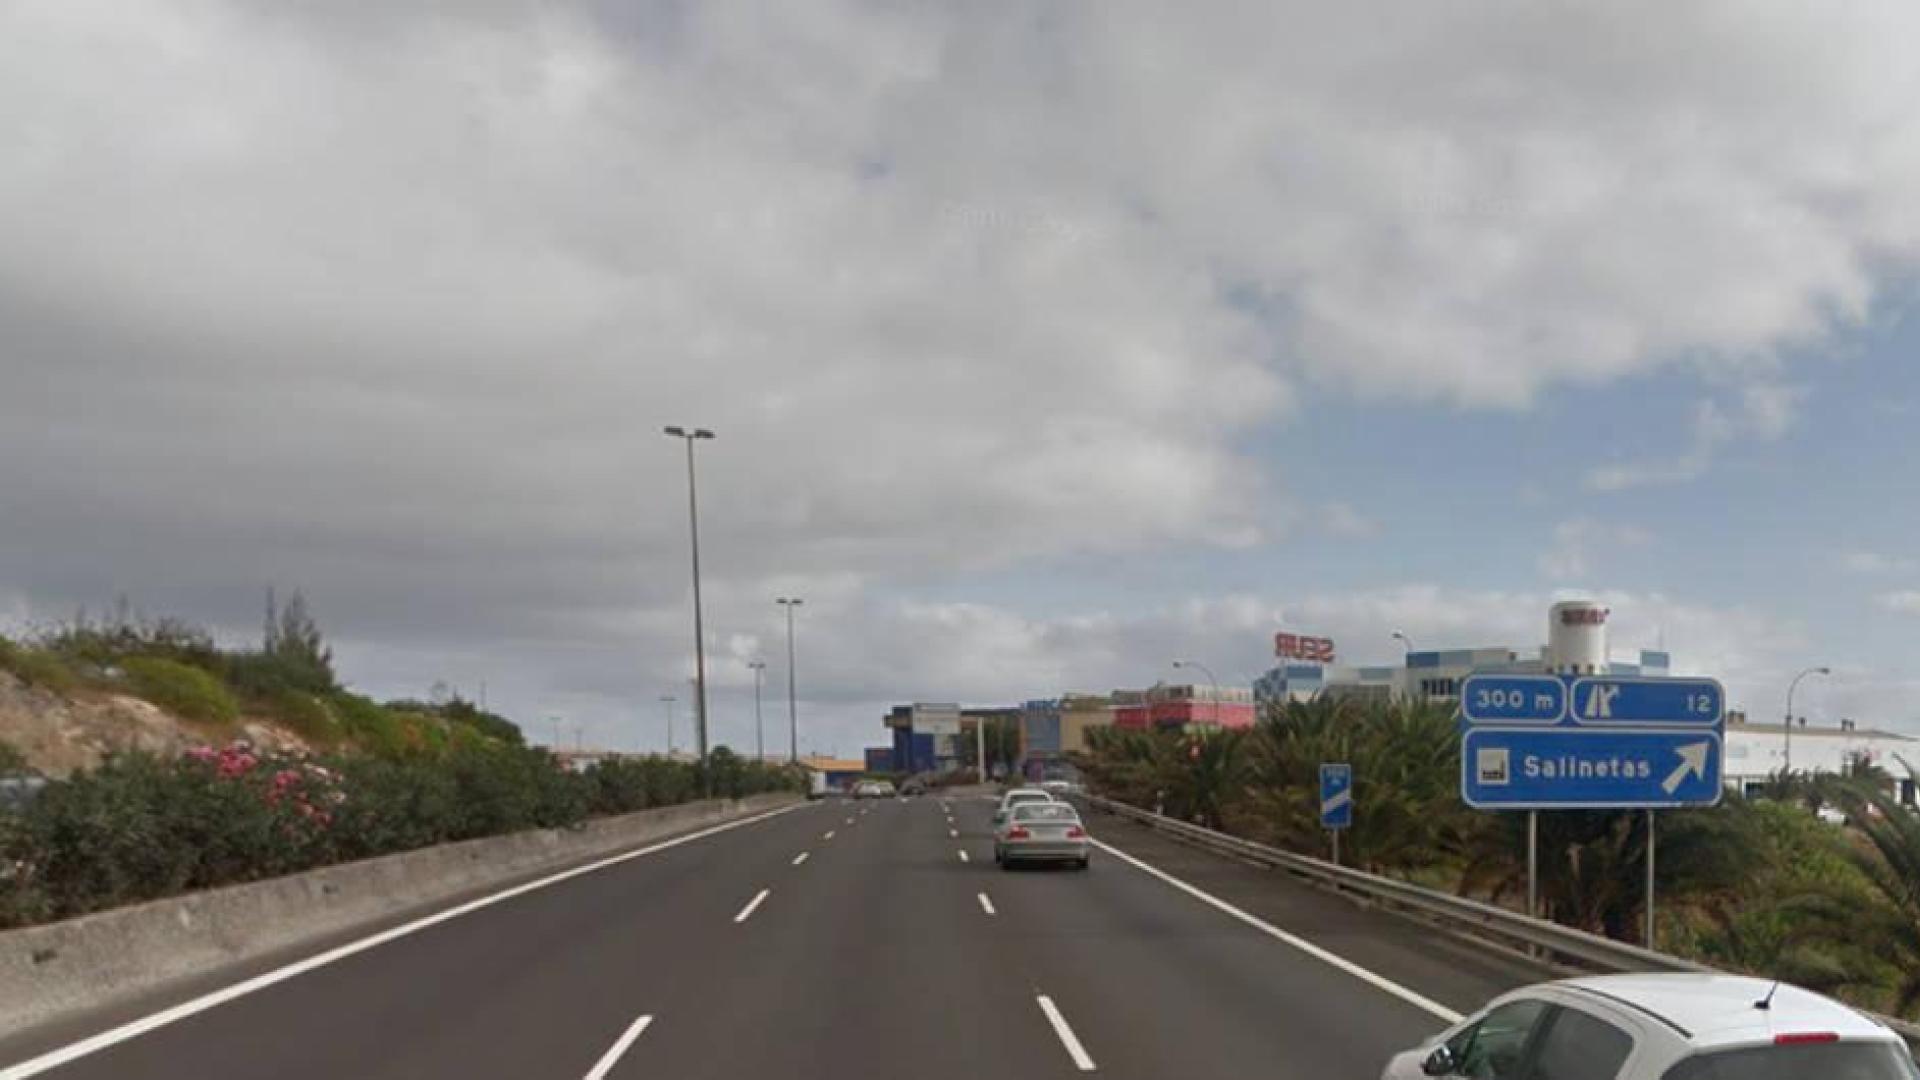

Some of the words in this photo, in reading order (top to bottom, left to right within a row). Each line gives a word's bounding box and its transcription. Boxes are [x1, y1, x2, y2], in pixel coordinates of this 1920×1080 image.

[1476, 689, 1524, 709] 300
[1535, 694, 1554, 710] m
[1687, 694, 1712, 713] 12
[1524, 755, 1650, 779] Salinetas
